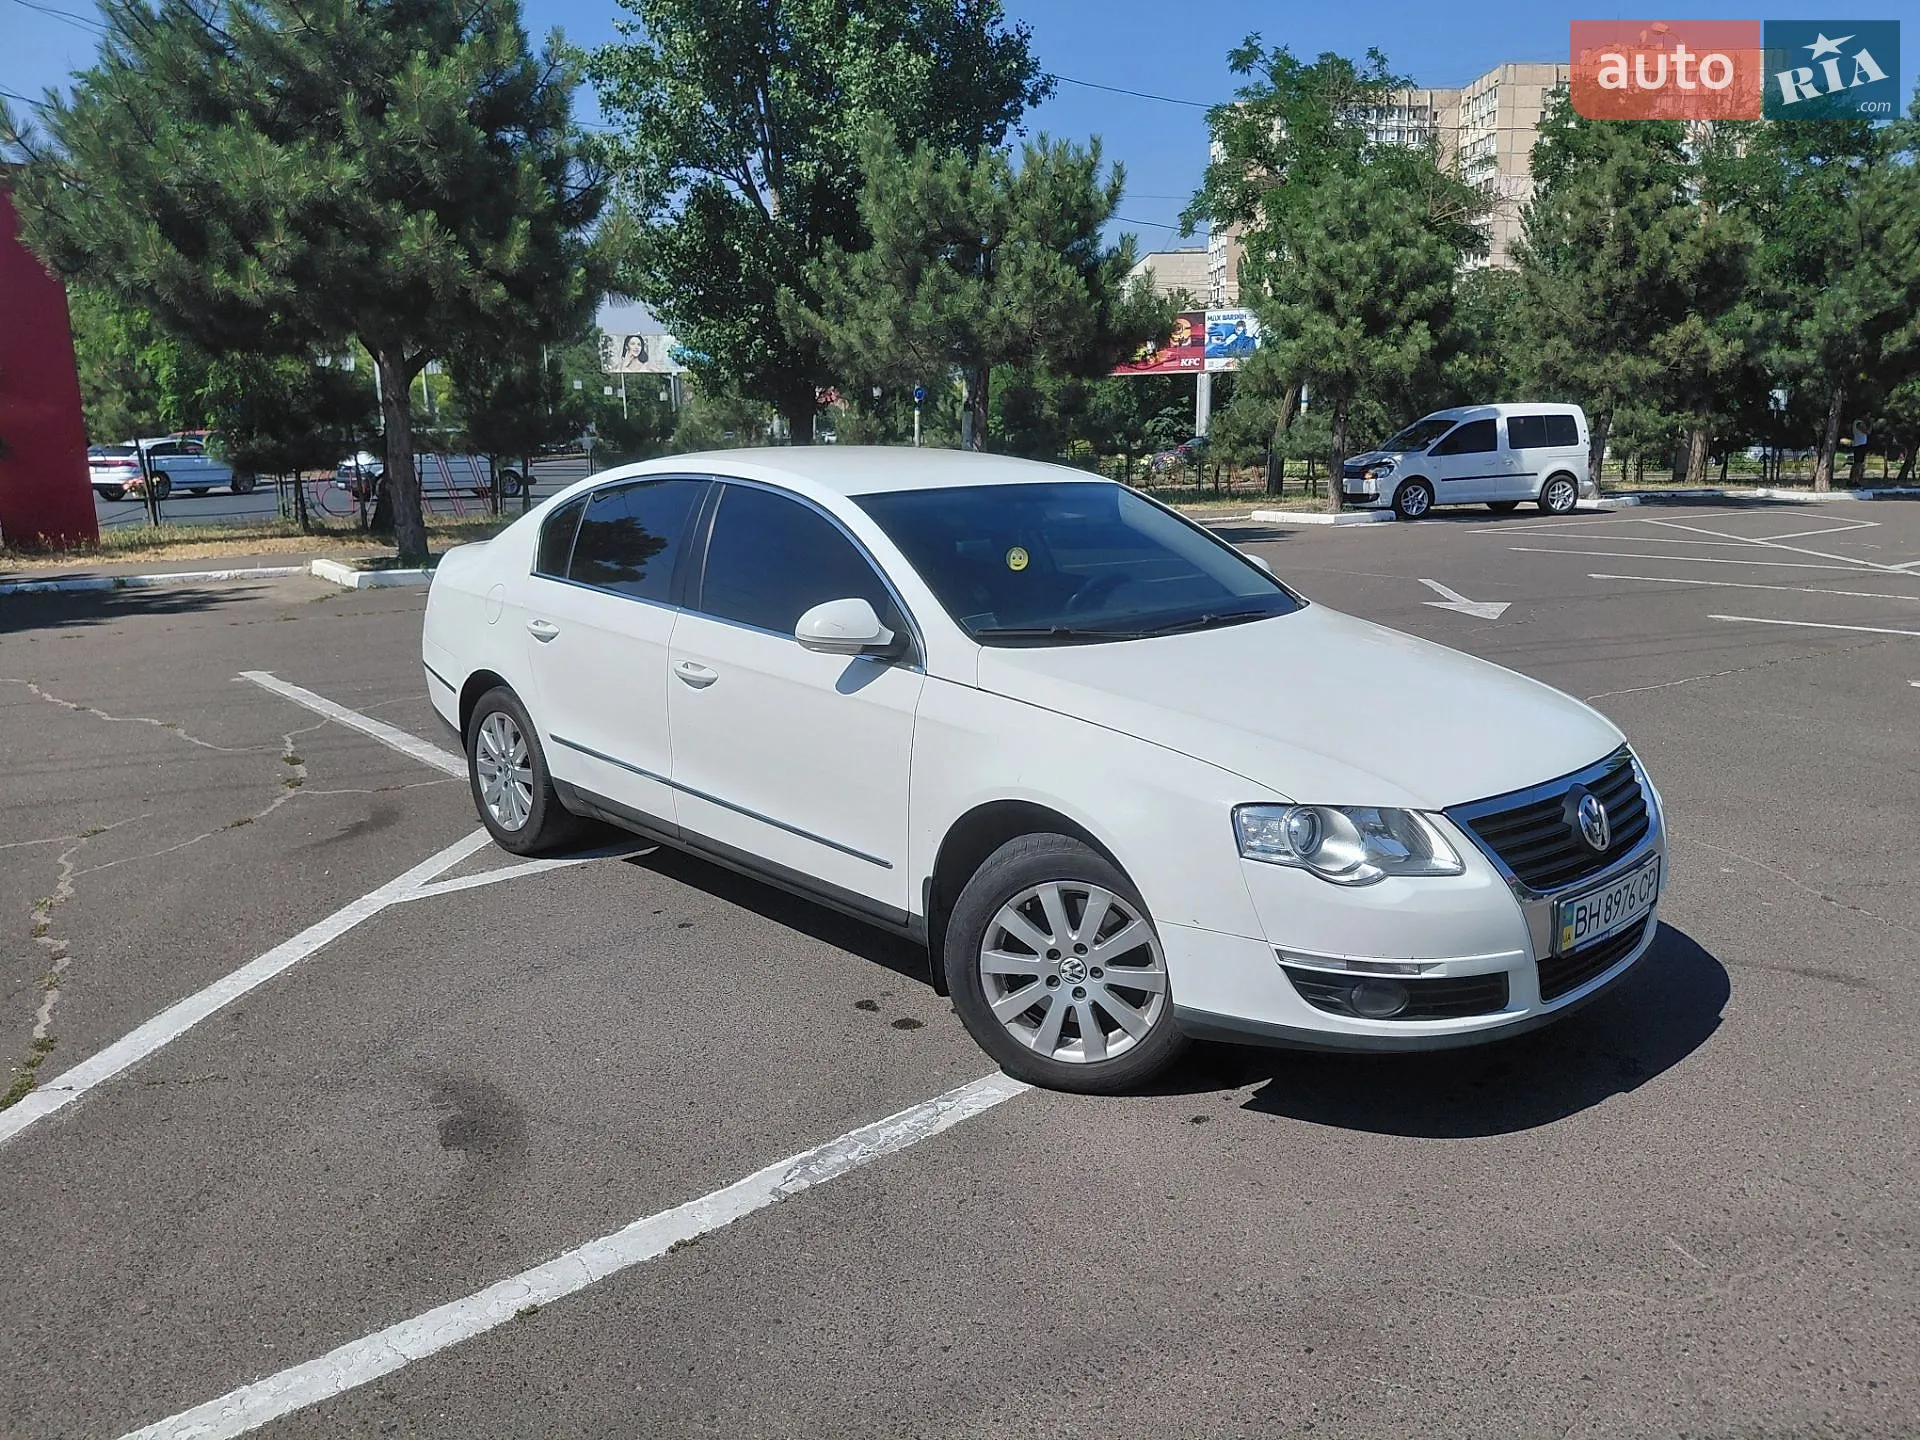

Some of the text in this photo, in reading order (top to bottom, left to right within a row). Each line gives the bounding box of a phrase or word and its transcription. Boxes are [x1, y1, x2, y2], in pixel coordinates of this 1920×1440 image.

[1180, 357, 1200, 367] KFC
[1574, 867, 1656, 939] BH 8976 CP
